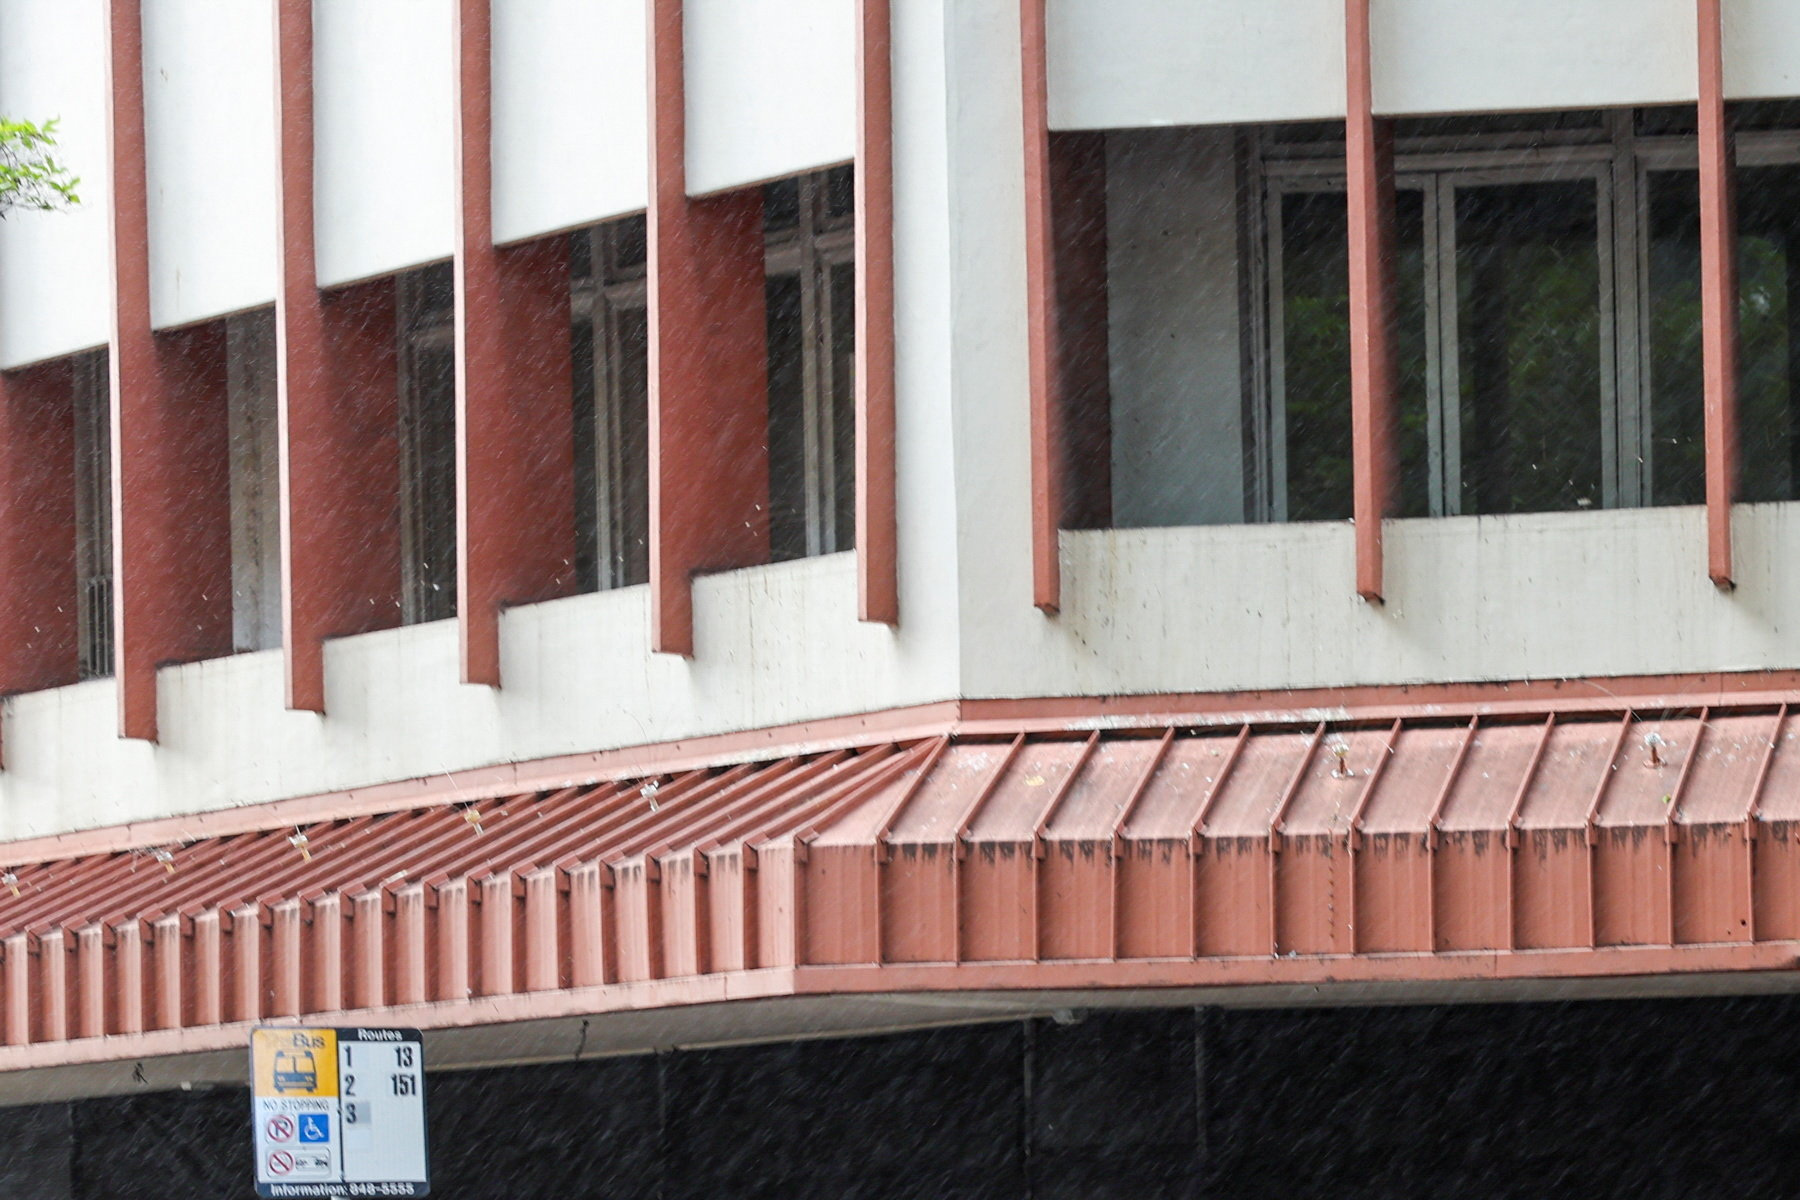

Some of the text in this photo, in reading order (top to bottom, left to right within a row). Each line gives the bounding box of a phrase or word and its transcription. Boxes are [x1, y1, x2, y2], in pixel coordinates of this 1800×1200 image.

[358, 1028, 402, 1041] Routes
[345, 1046, 352, 1067] 1
[394, 1046, 413, 1067] 13
[345, 1074, 356, 1096] 2
[391, 1074, 416, 1096] 151
[263, 1100, 329, 1111] NO STOPPING
[345, 1103, 357, 1124] 3
